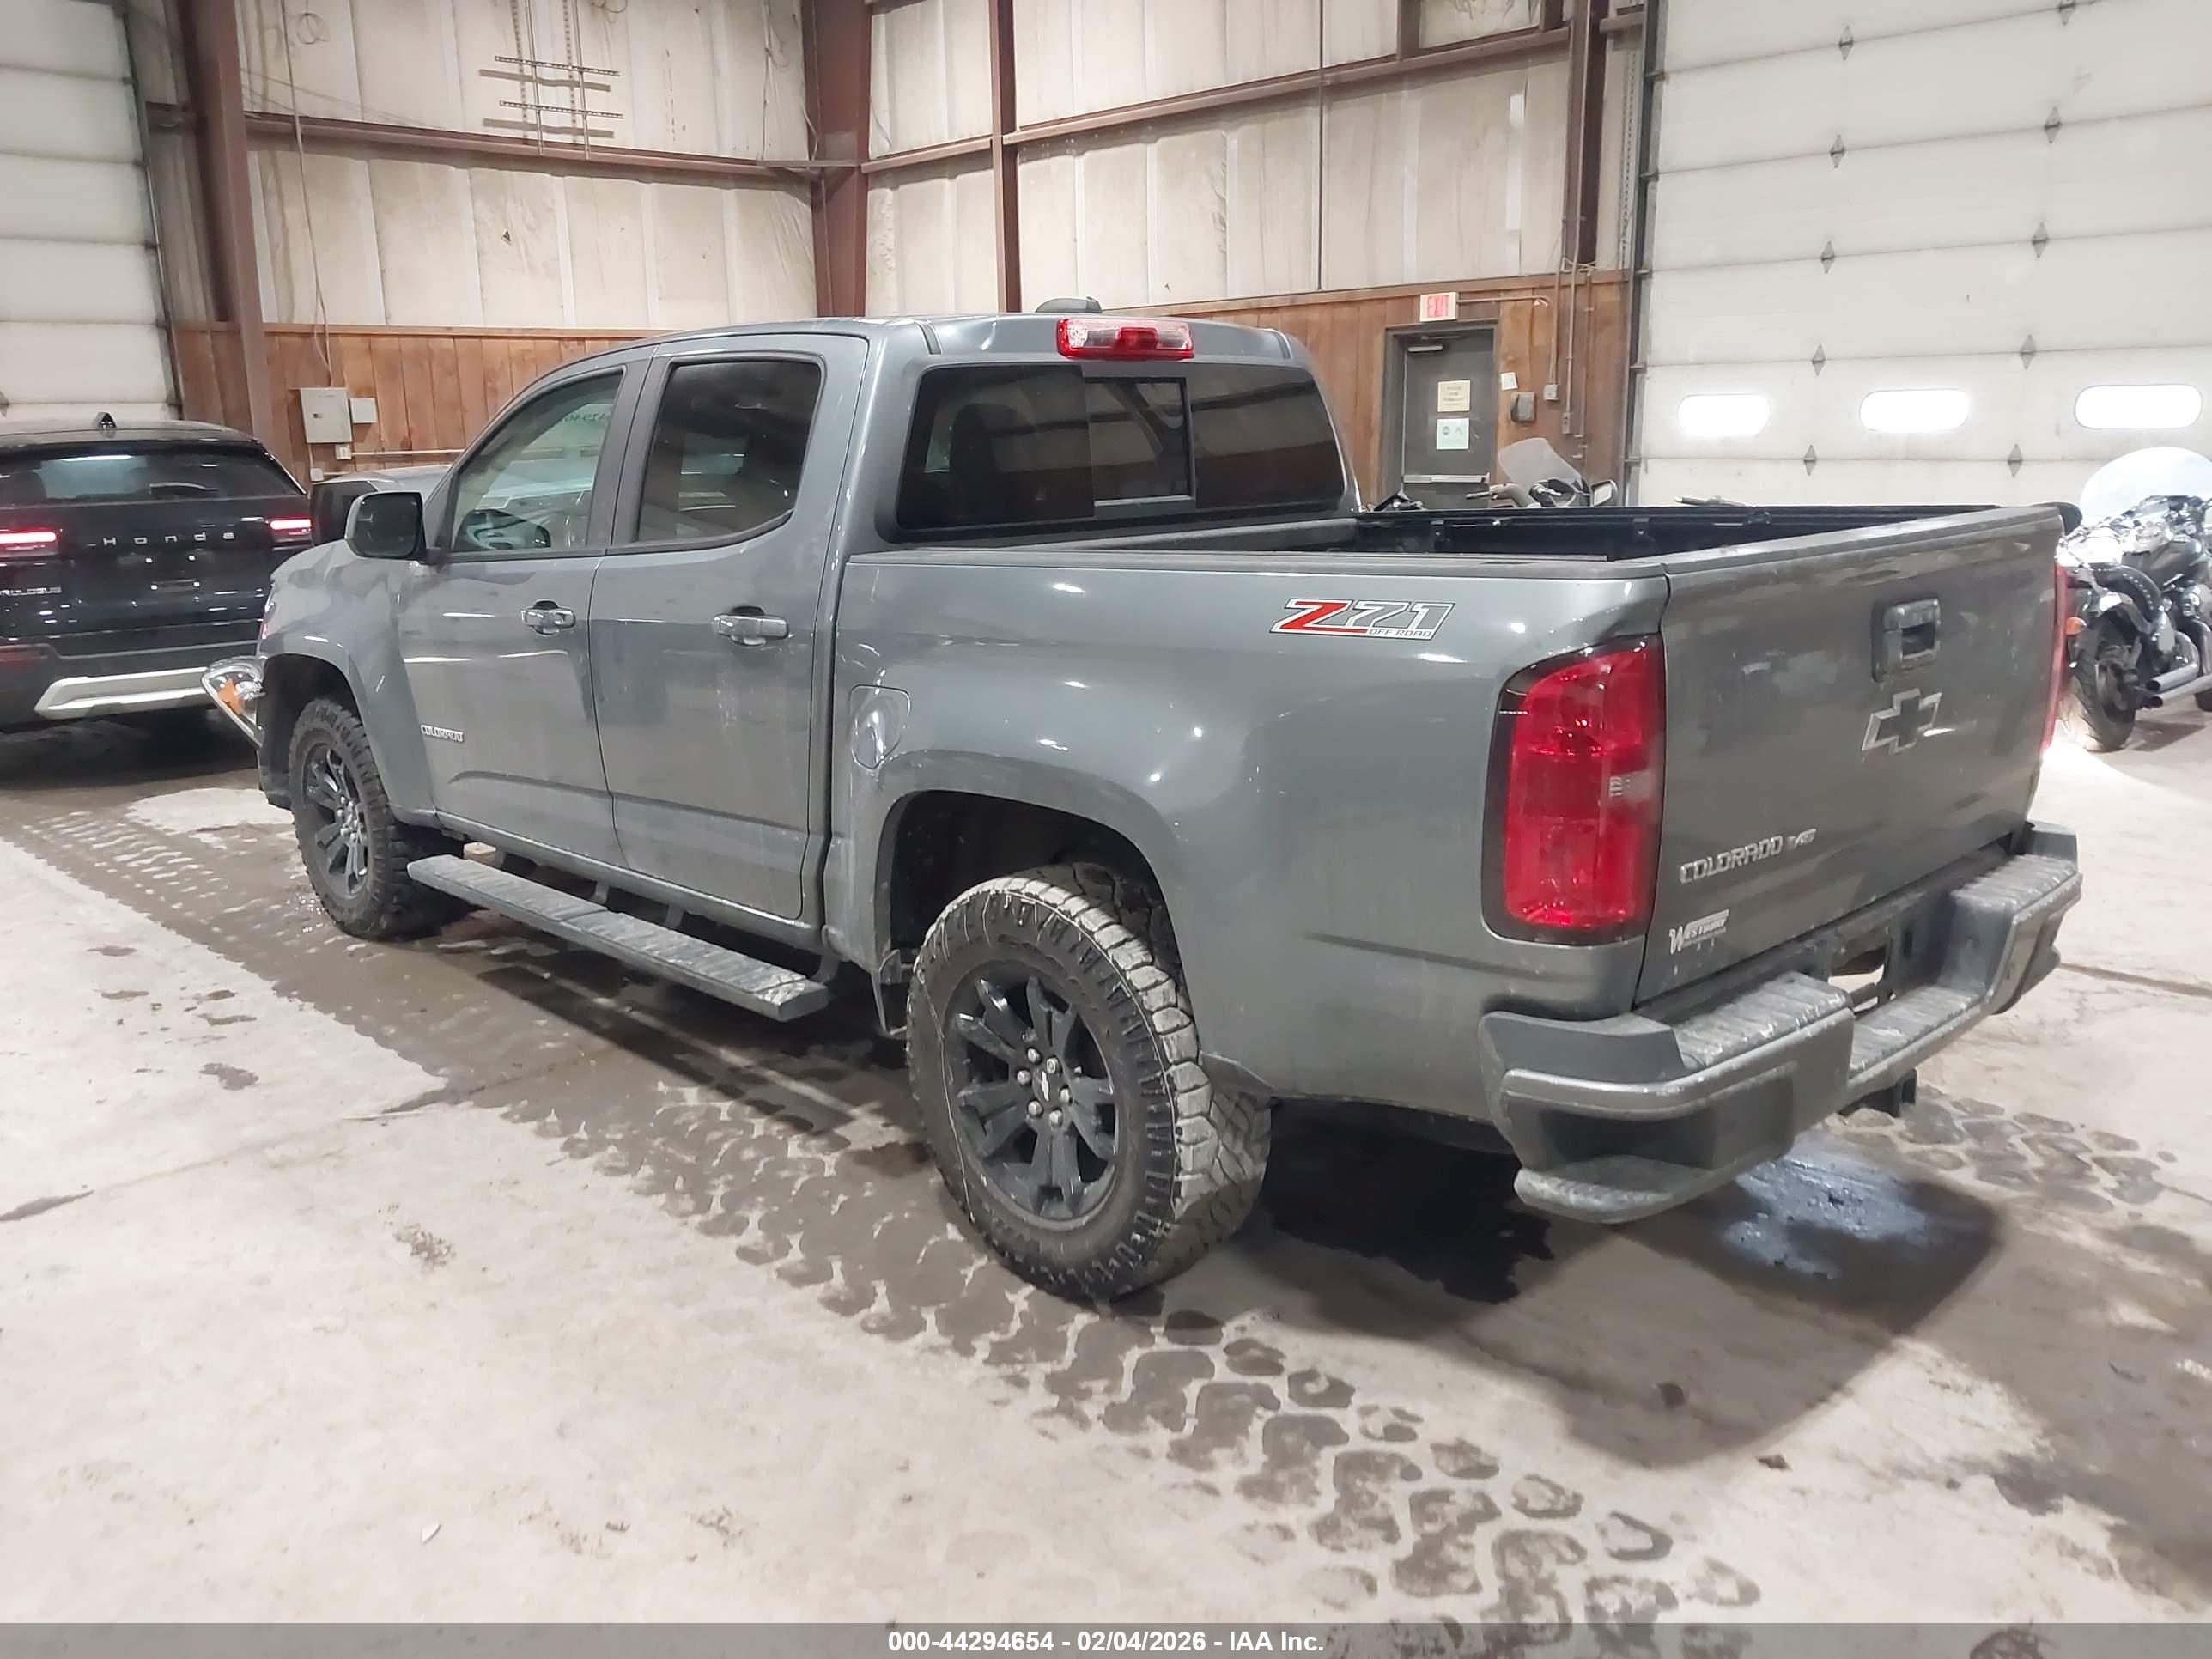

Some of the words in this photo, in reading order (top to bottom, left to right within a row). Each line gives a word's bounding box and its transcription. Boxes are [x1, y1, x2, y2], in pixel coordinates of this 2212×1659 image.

[1269, 598, 1455, 640] Z71
[1395, 629, 1432, 638] ROAD
[420, 725, 464, 743] COLORADO
[1680, 835, 1784, 885] COLORADO
